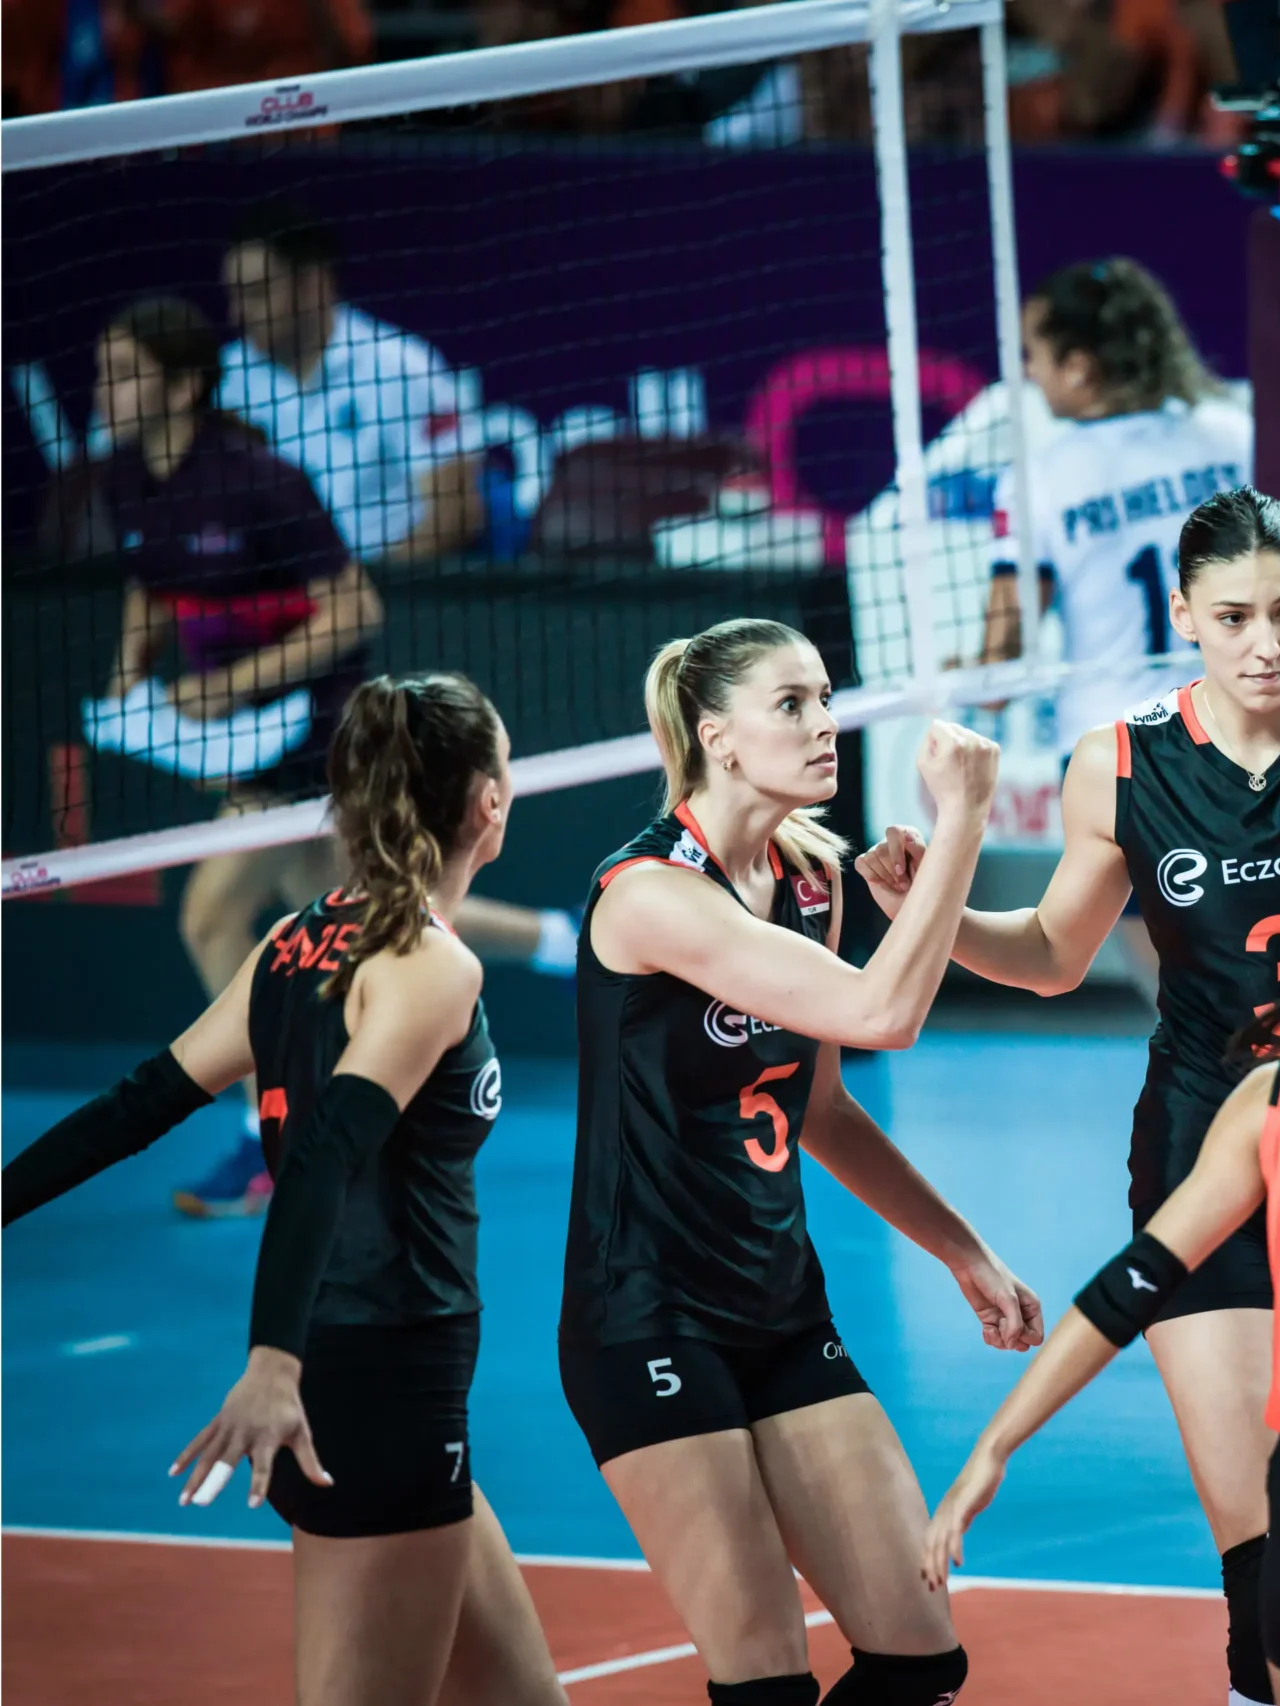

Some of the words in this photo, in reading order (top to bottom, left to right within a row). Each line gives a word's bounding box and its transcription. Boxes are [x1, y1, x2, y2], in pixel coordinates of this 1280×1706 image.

[739, 1062, 799, 1172] 5
[647, 1357, 682, 1397] 5
[445, 1441, 464, 1482] 7
